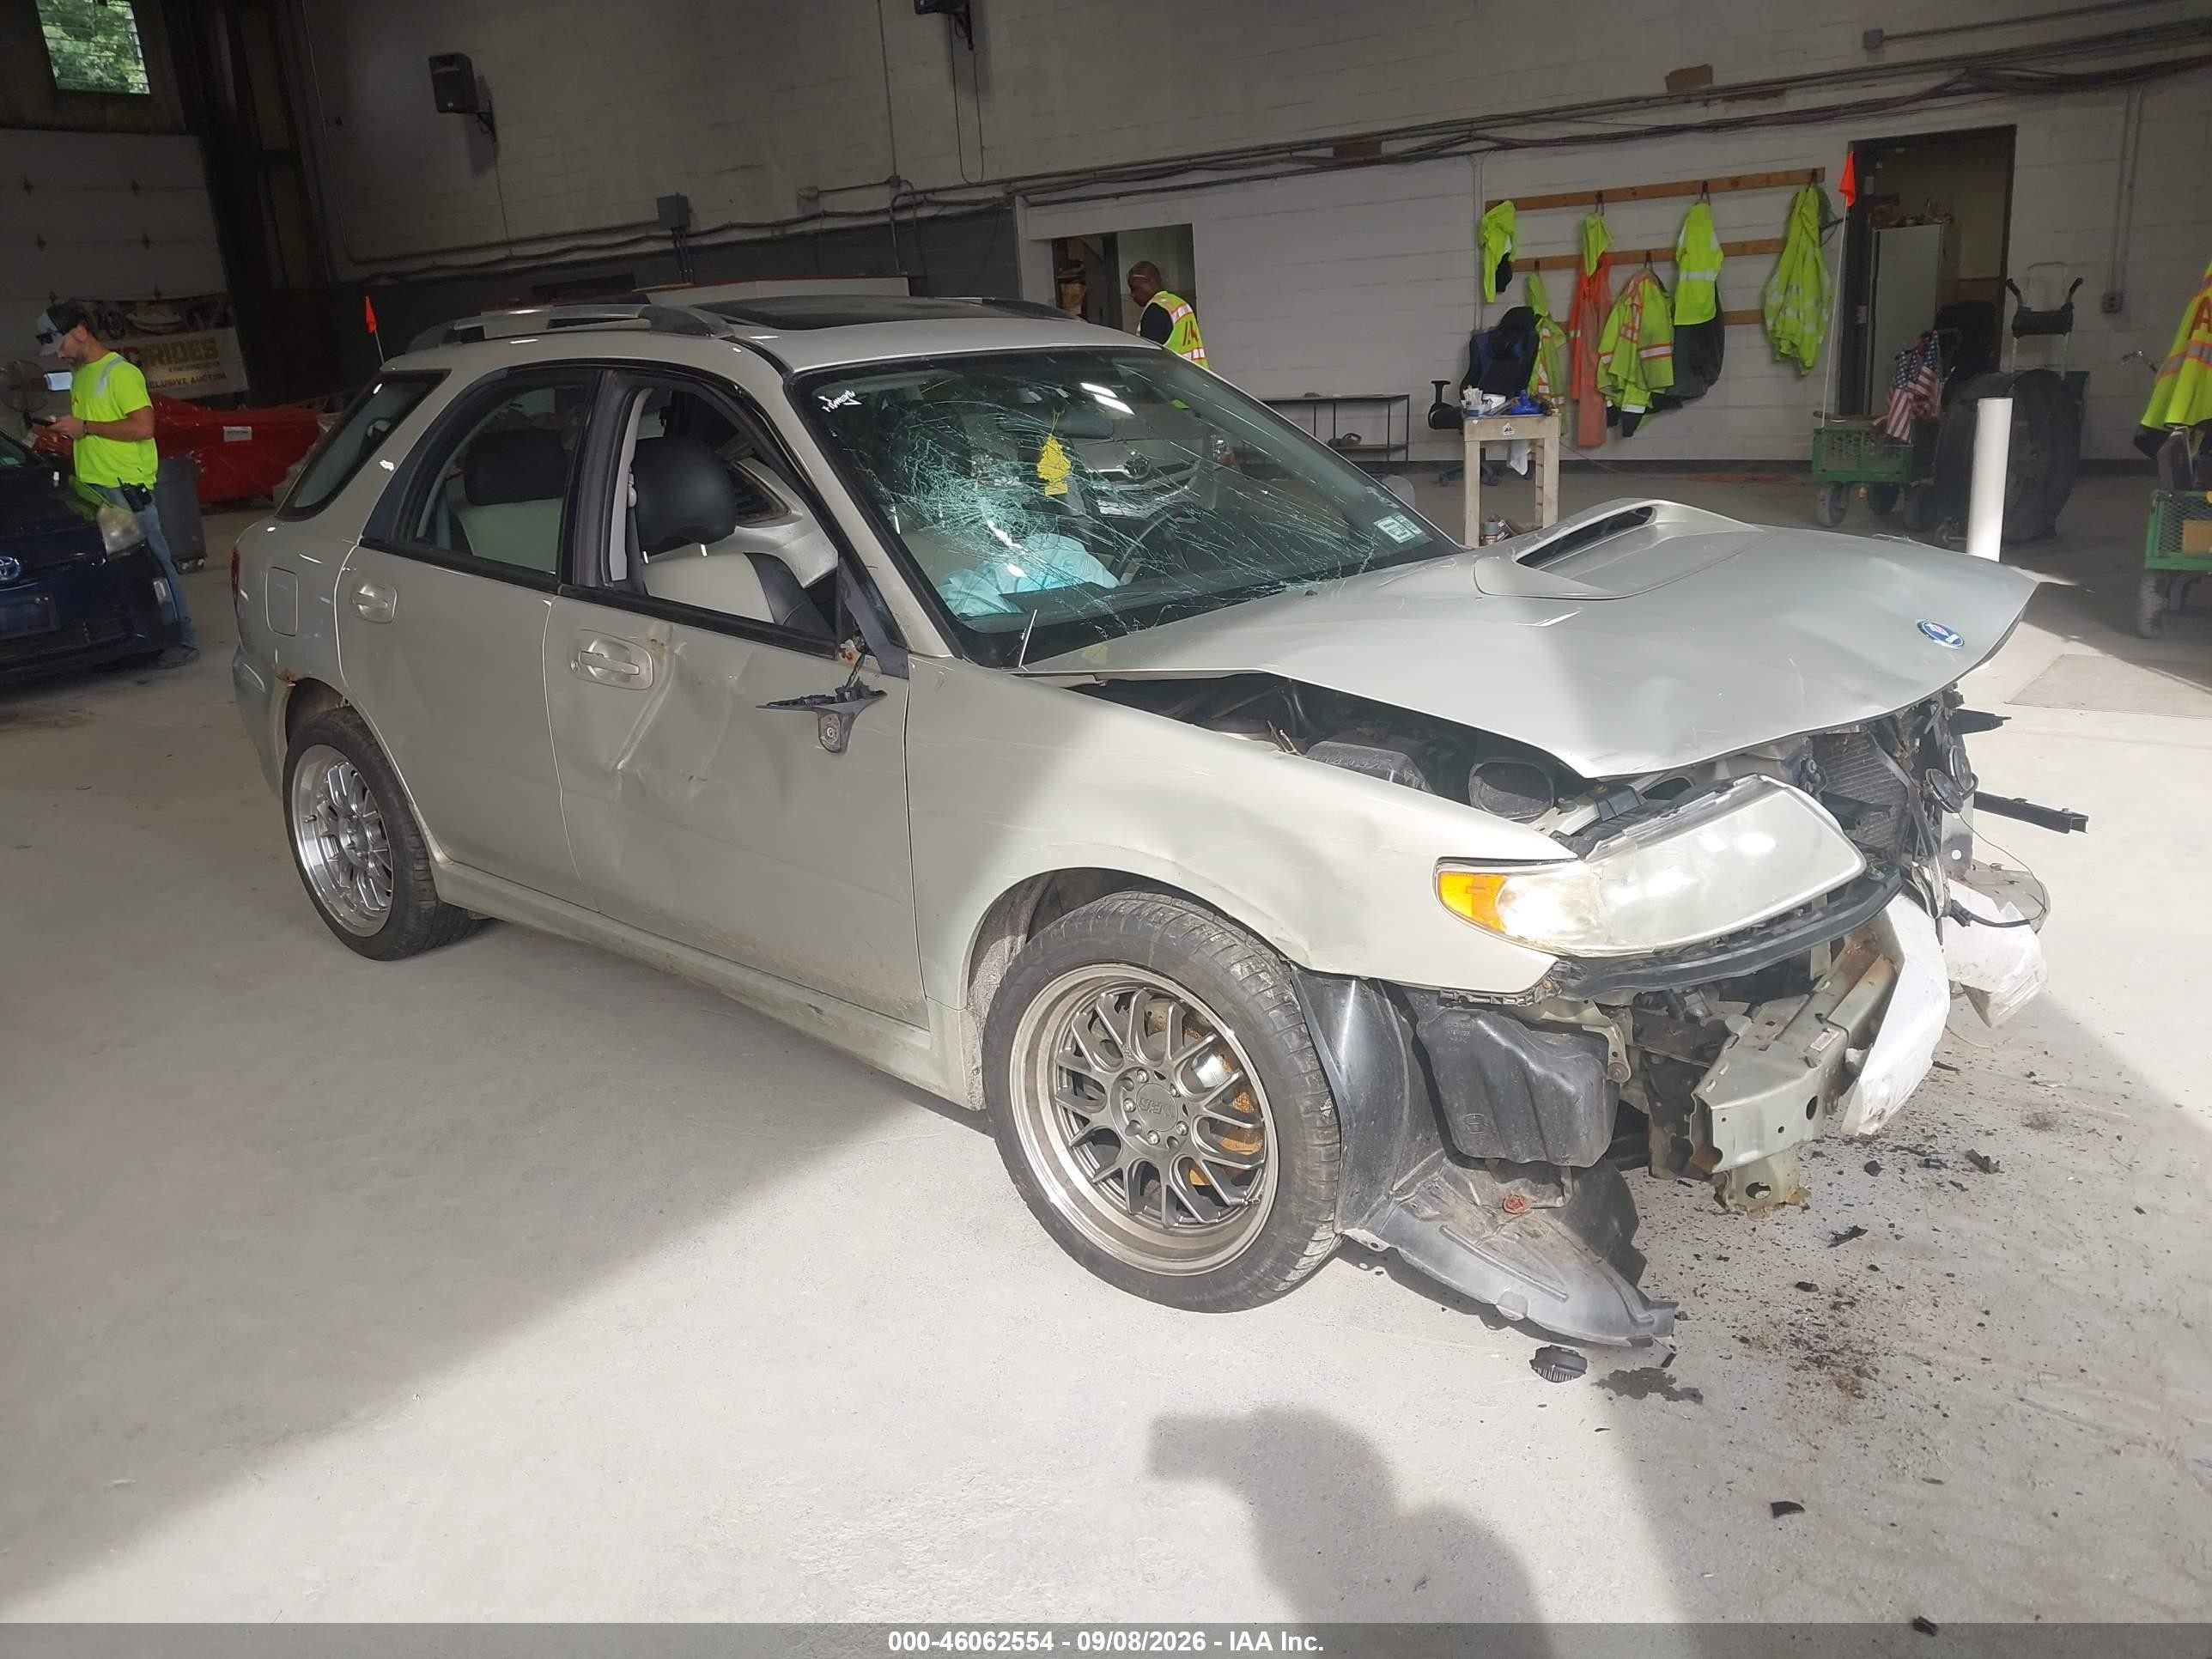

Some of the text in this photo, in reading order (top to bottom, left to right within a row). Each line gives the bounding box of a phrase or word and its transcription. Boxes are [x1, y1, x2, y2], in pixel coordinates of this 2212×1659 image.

[147, 337, 218, 368] RIDES
[149, 373, 227, 388] CLUSIVE AUCTION
